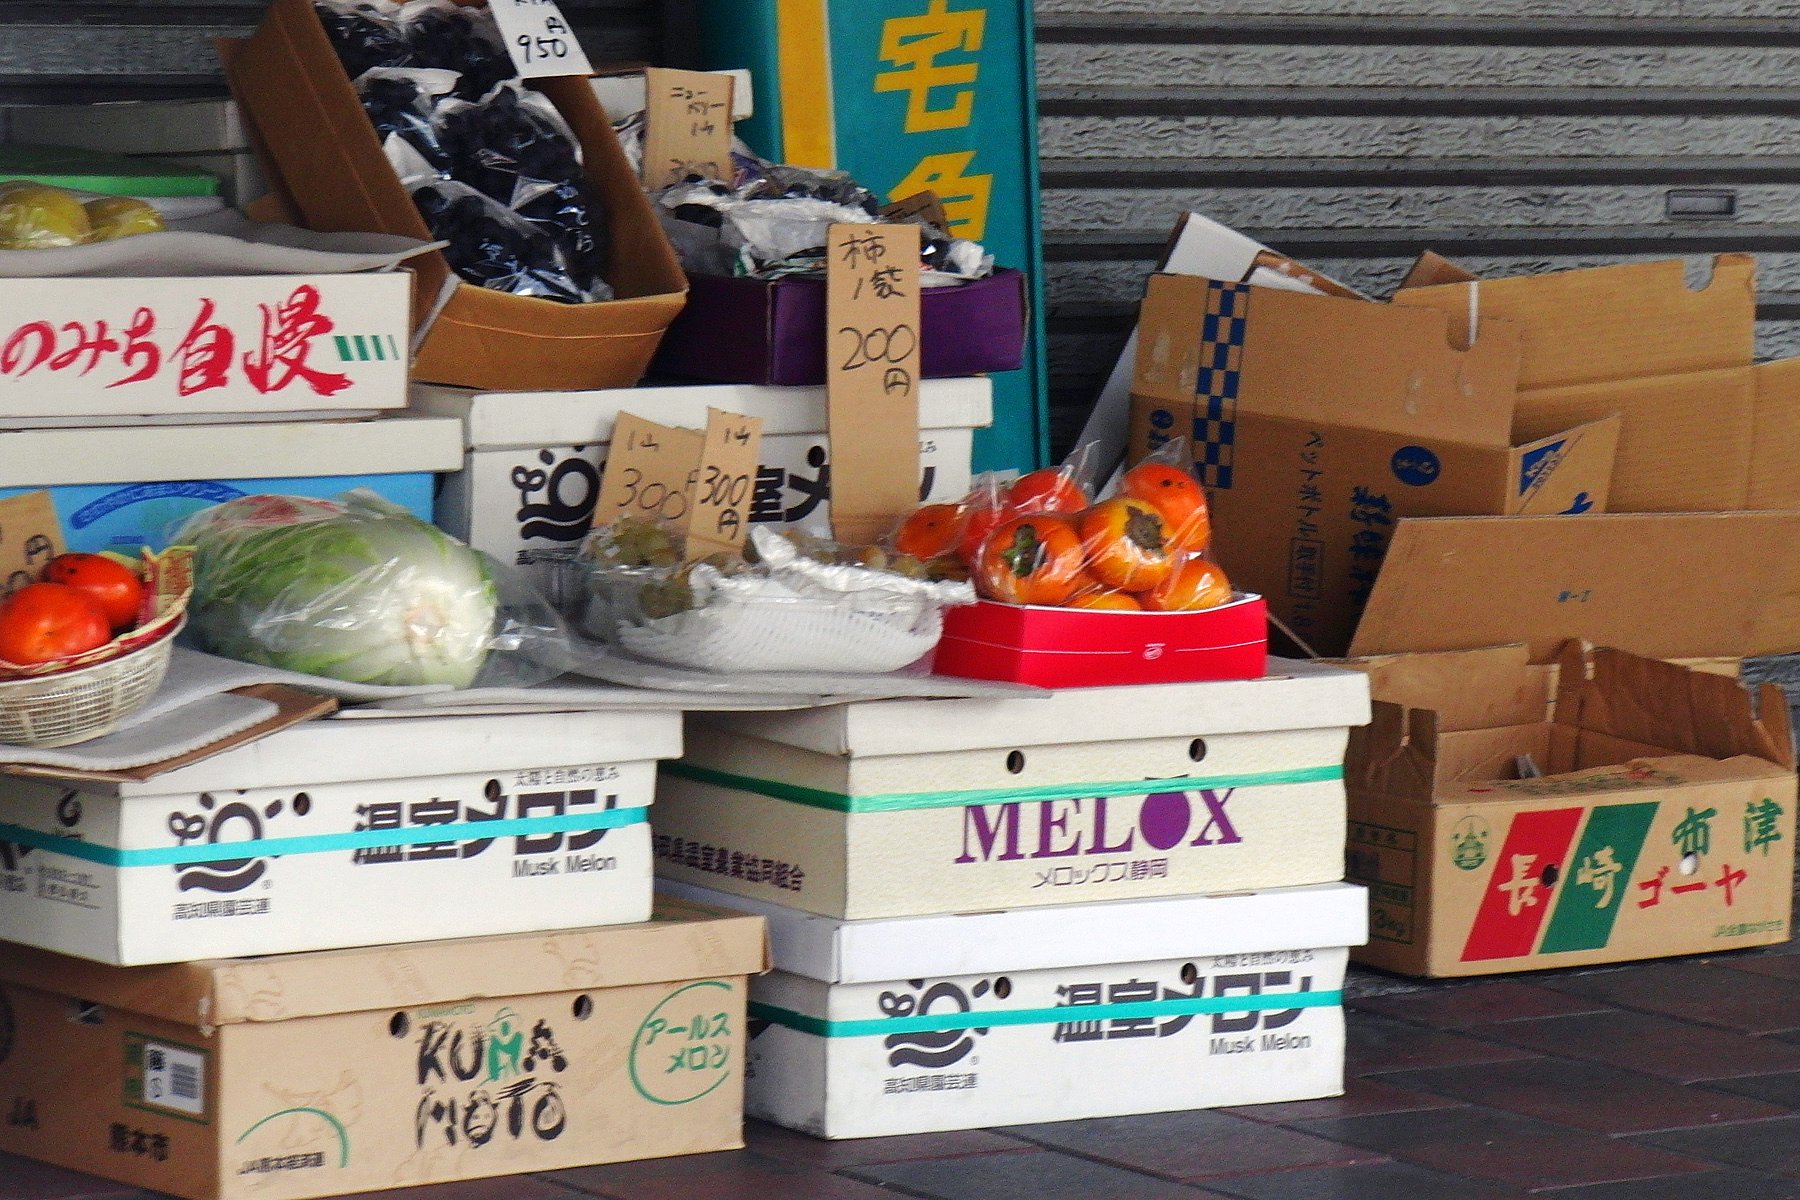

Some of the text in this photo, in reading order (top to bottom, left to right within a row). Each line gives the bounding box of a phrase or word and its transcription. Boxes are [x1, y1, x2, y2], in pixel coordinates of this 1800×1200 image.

[517, 34, 568, 64] 950
[838, 230, 886, 270] 柿
[838, 323, 916, 371] 200
[700, 465, 749, 507] 300
[512, 853, 617, 878] Musk Melon
[1031, 857, 1169, 889] メロックス静岡
[1636, 863, 1747, 910] ゴーヤ
[1208, 1032, 1312, 1056] Musk Melon
